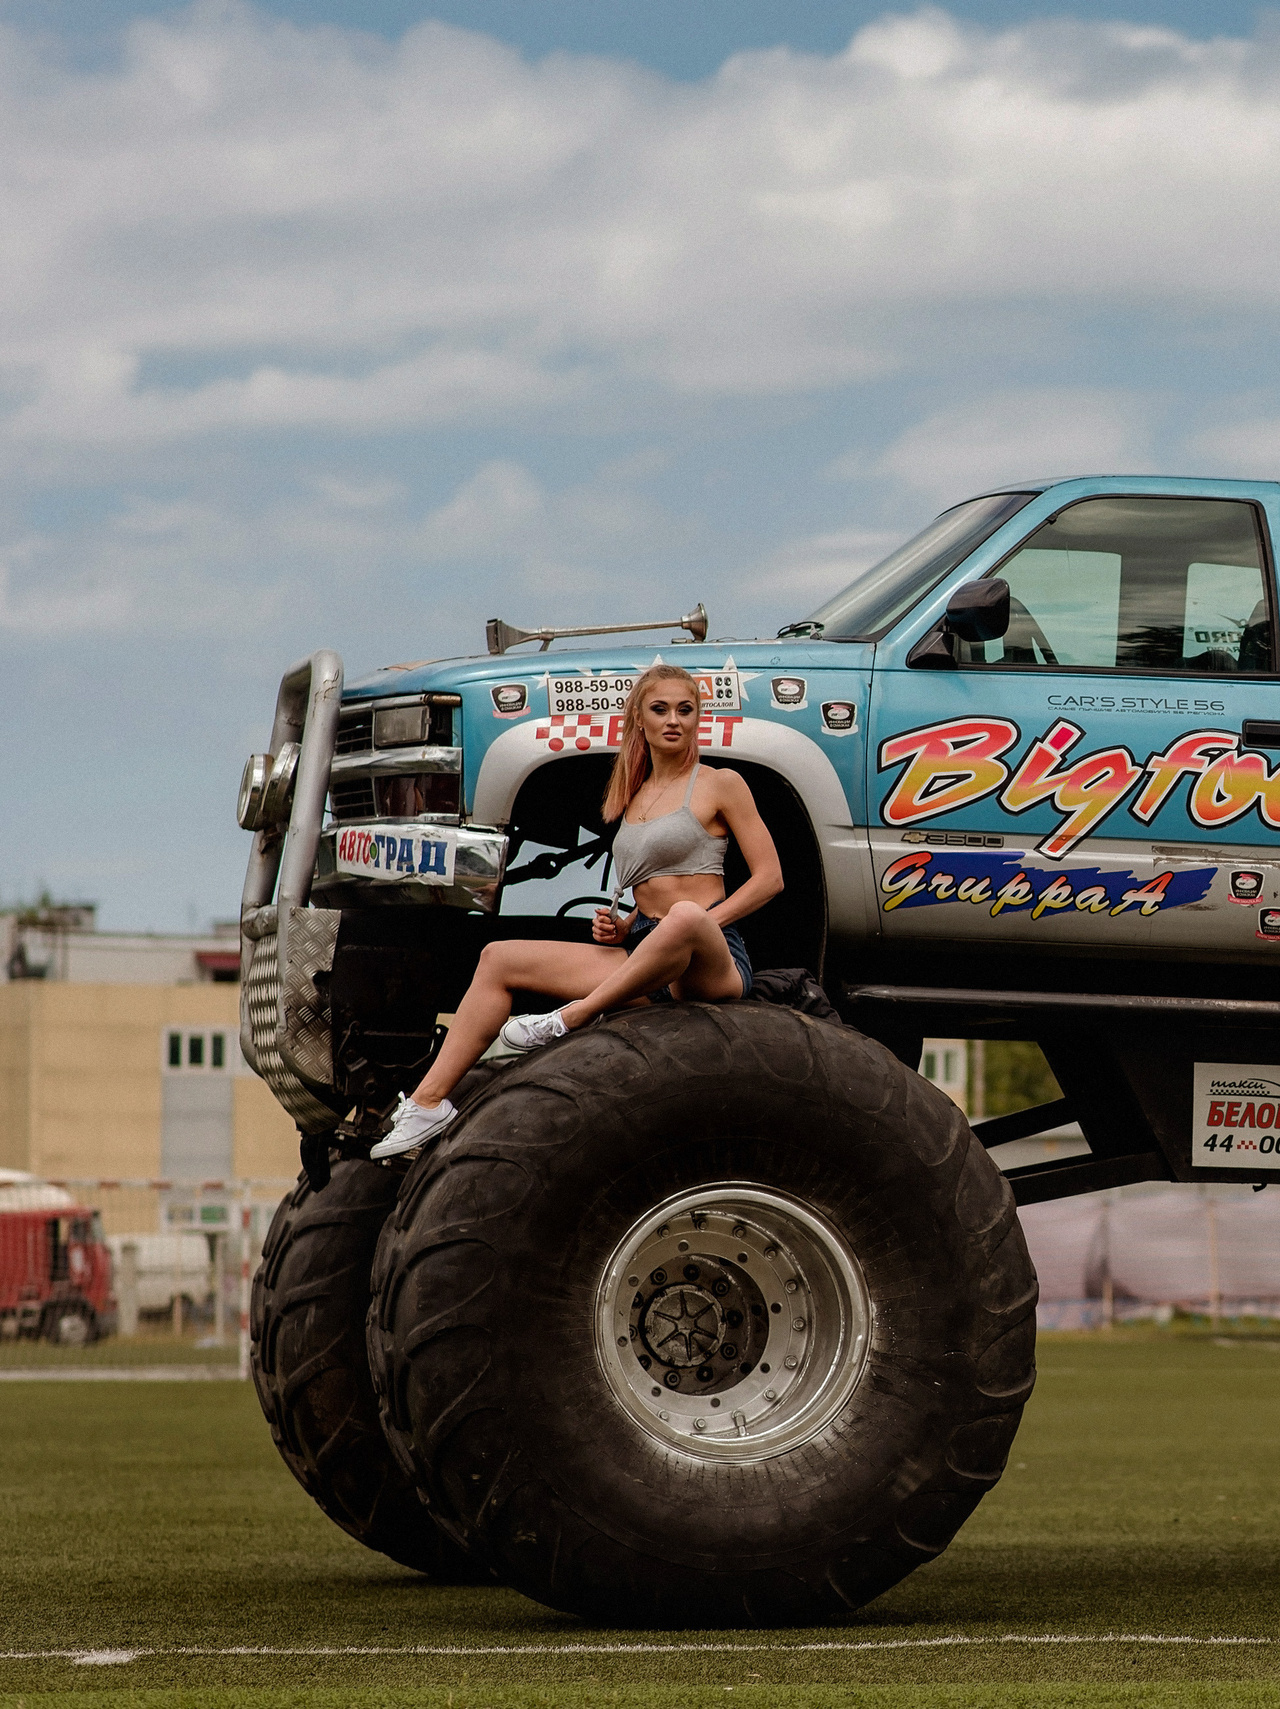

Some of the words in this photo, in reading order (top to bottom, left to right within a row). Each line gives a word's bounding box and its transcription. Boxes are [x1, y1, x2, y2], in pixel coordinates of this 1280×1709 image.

[555, 678, 633, 694] 988-59-09
[555, 697, 625, 712] 988-50-9
[1047, 695, 1116, 708] CAR'S
[1121, 697, 1189, 710] STYLE
[1194, 700, 1225, 711] 56
[927, 832, 1005, 848] 3500
[1210, 1079, 1267, 1090] такси
[1203, 1133, 1234, 1152] 44
